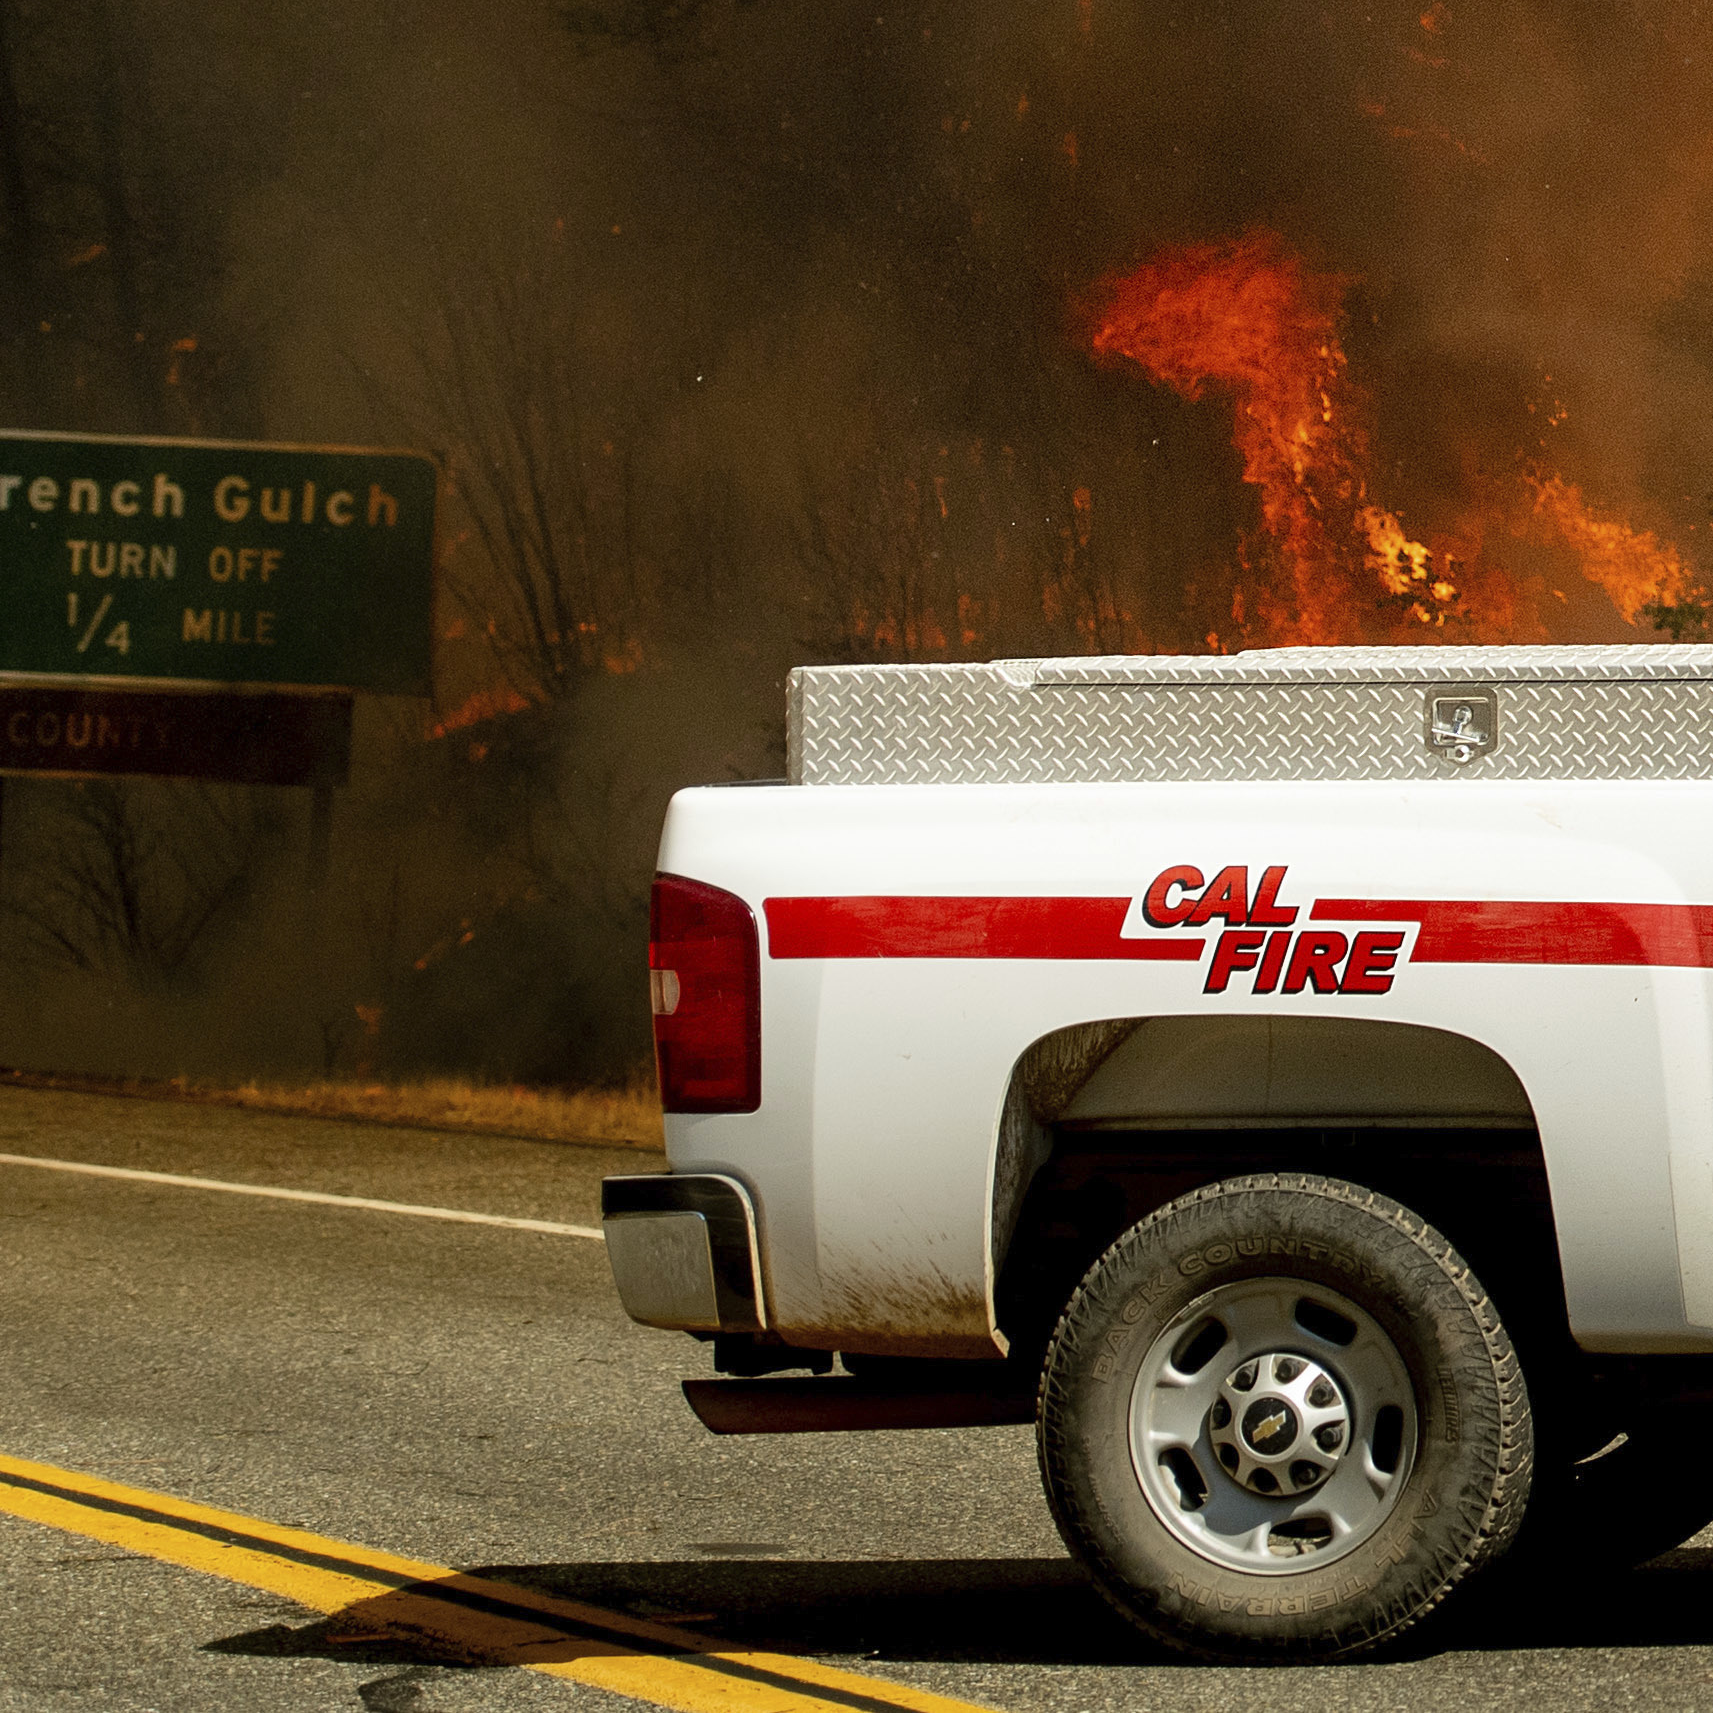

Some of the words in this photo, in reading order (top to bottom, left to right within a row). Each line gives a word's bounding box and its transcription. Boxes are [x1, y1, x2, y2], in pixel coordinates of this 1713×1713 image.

[214, 476, 398, 526] Gulch
[66, 540, 177, 579] TURN
[209, 547, 283, 582] OFF
[67, 593, 130, 654] 1/4
[183, 608, 276, 645] MILE
[7, 712, 174, 749] COUNTY
[1142, 865, 1299, 928] CAL
[1202, 931, 1405, 995] FIRE
[1091, 1275, 1170, 1384] BACK
[1178, 1235, 1386, 1289] COUNTRY
[1374, 1492, 1441, 1569] ALL
[1168, 1571, 1369, 1618] TERRAIN
